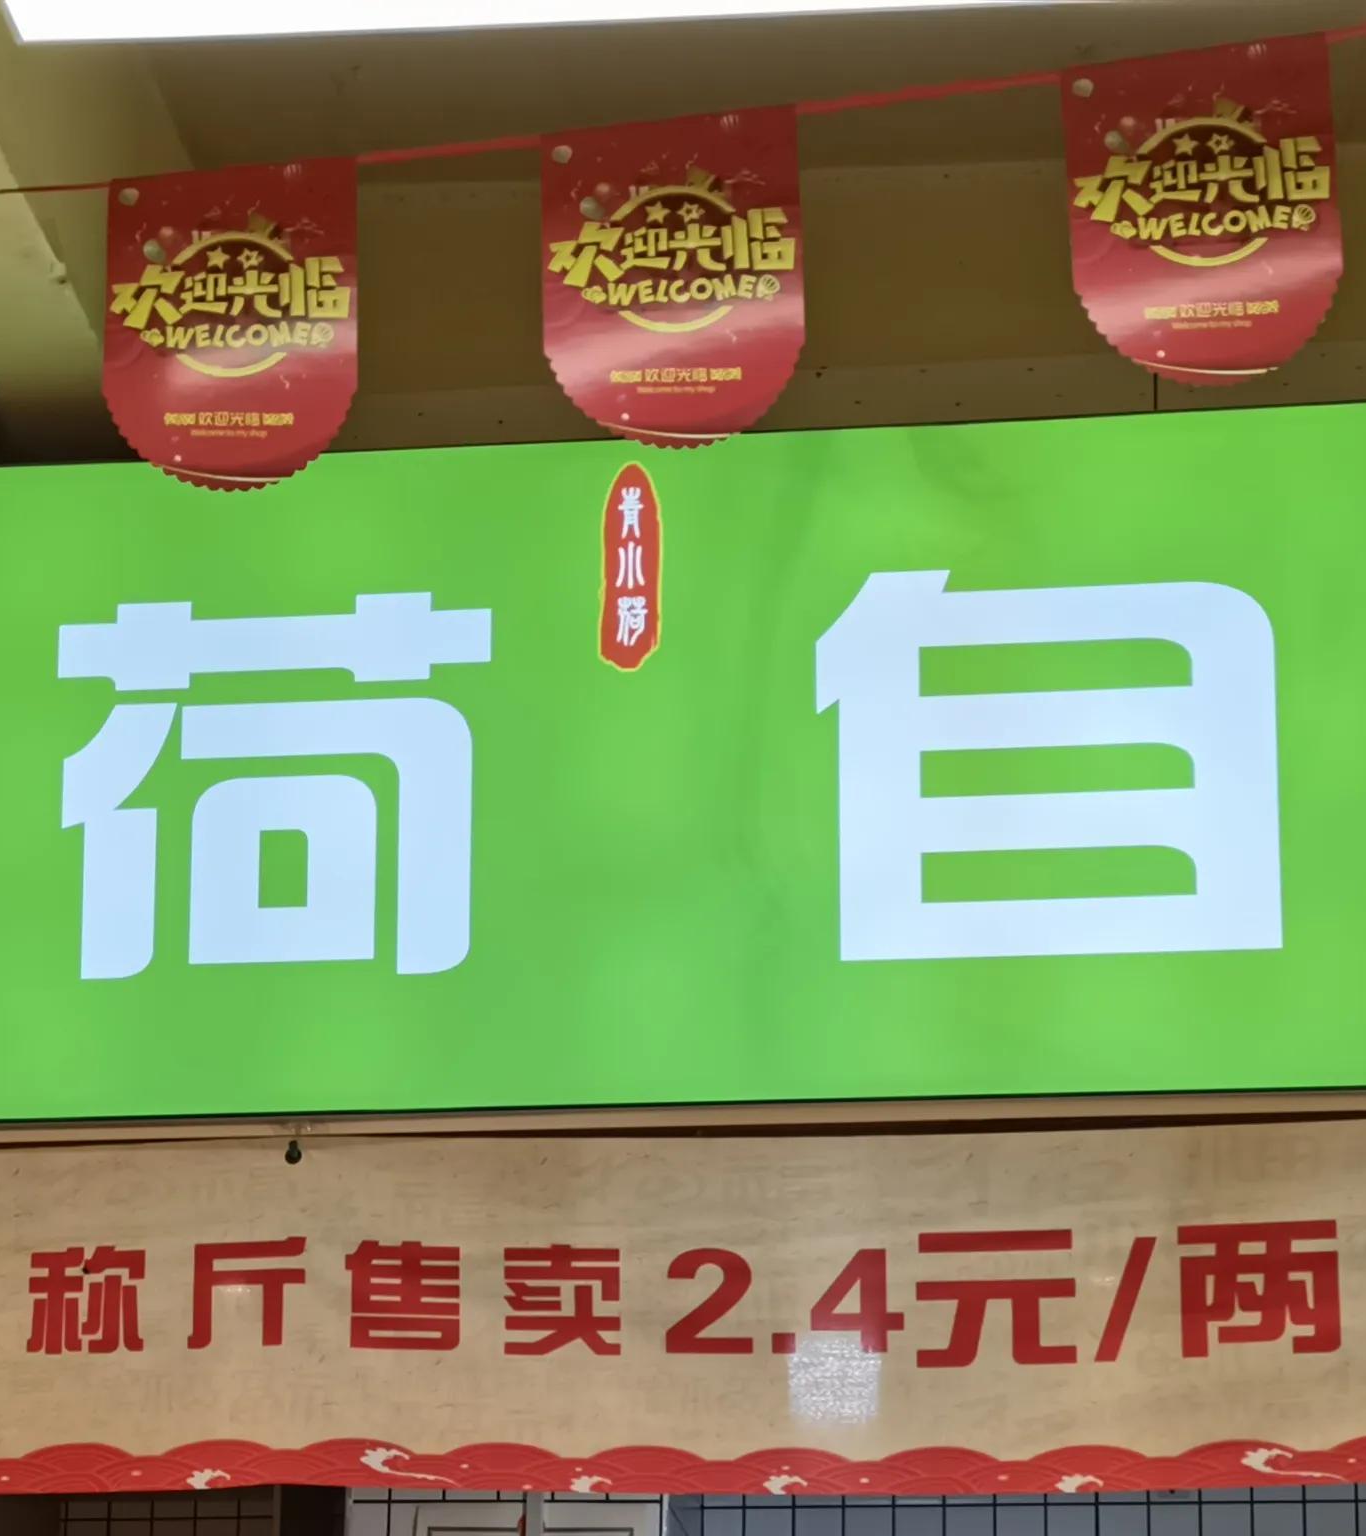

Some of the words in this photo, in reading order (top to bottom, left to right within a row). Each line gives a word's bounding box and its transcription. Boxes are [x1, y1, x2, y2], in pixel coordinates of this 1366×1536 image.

[1073, 136, 1330, 222] 欢迎光临
[547, 207, 796, 288] 欢迎光临
[1137, 205, 1293, 241] WELCOME
[109, 256, 351, 329] 欢迎光临
[608, 273, 758, 307] WELCOME
[166, 321, 313, 349] WELCOME
